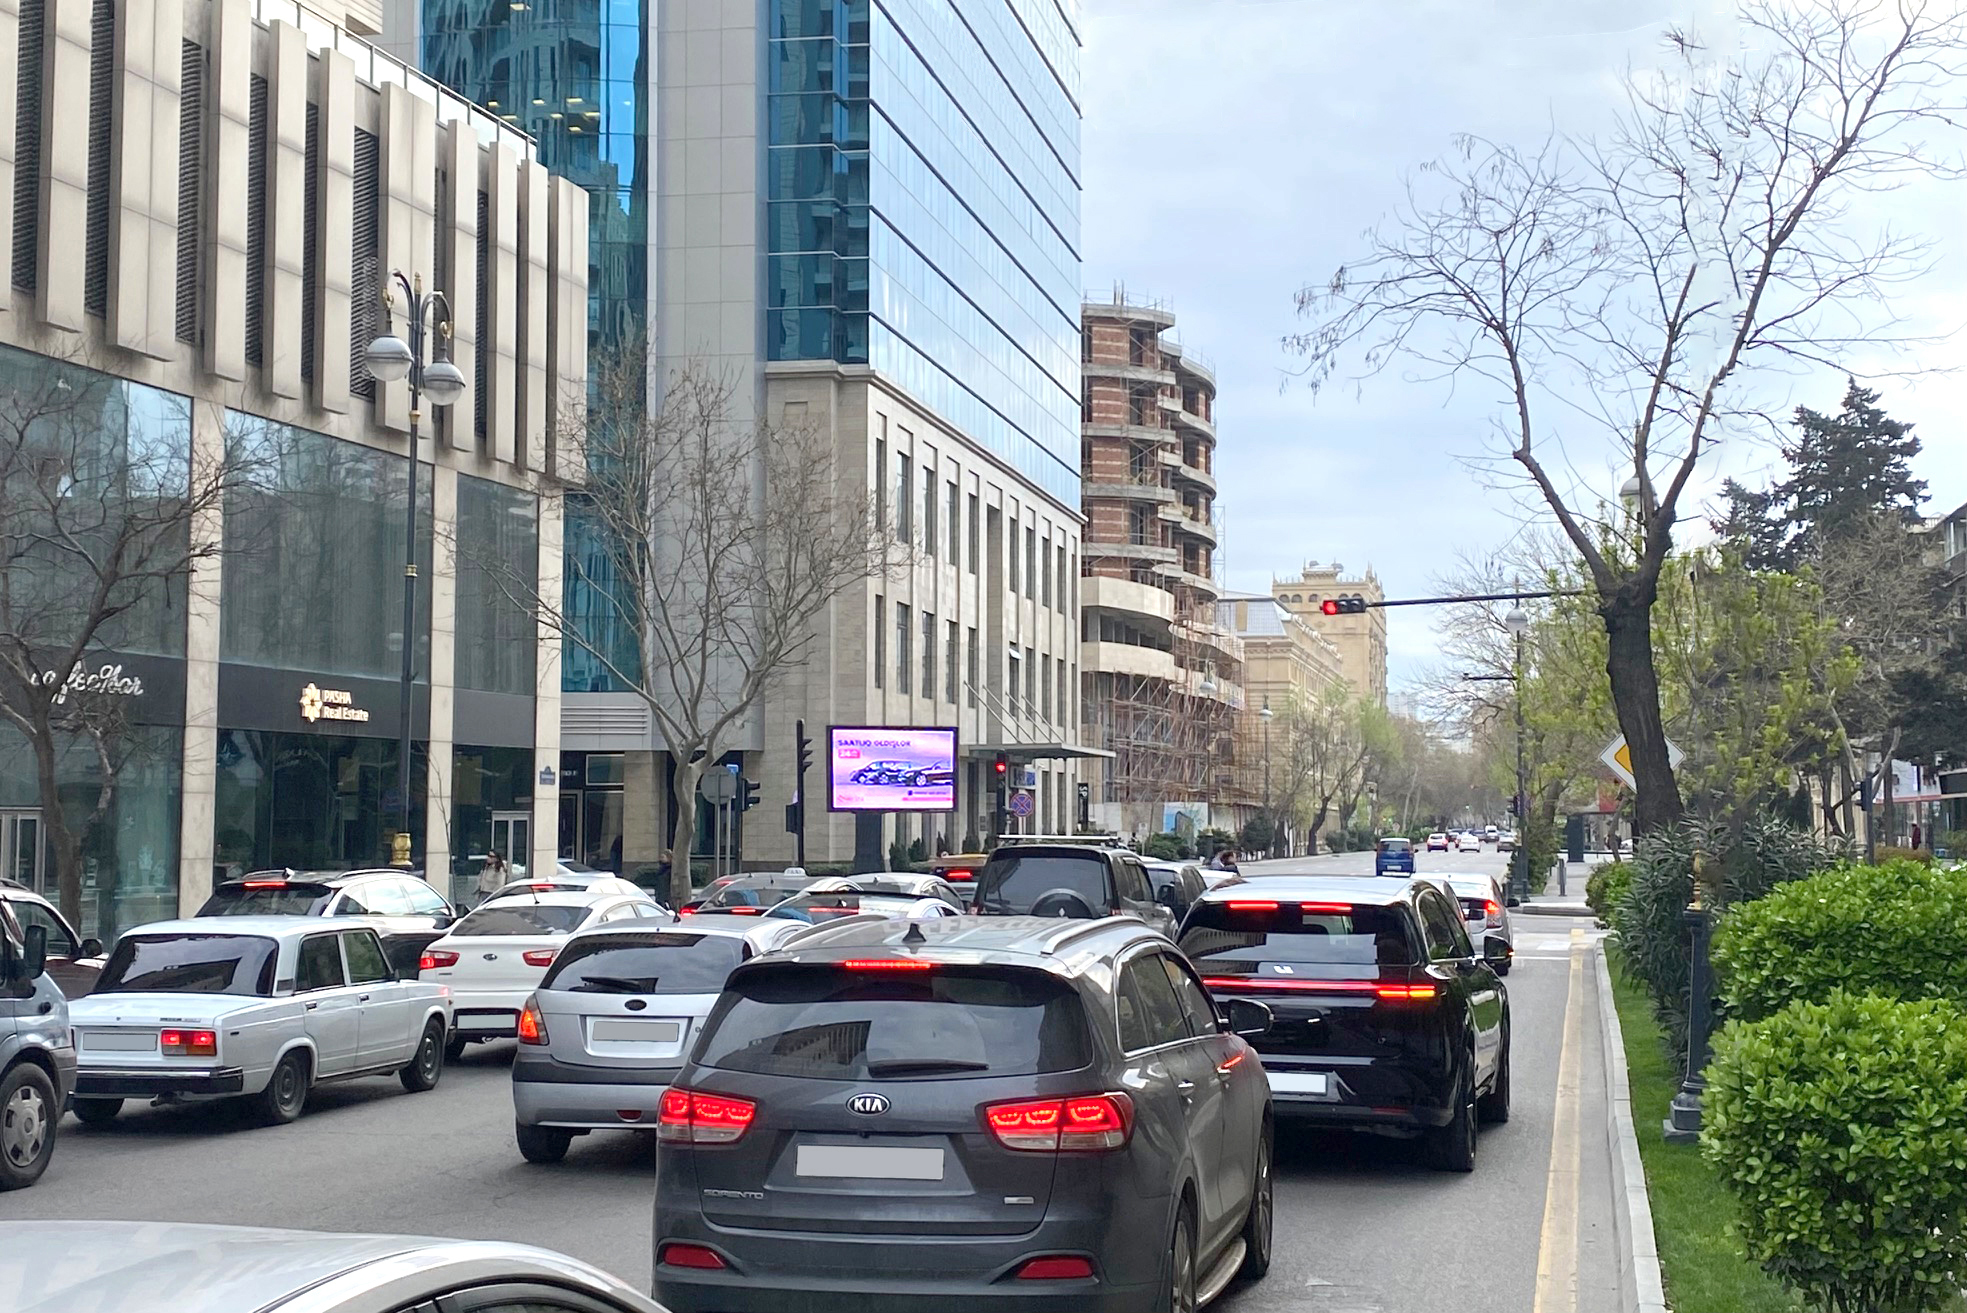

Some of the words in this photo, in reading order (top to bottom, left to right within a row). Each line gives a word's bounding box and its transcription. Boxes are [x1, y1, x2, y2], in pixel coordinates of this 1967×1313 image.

[322, 689, 352, 704] PASHA
[322, 706, 342, 719] Real
[343, 706, 369, 722] Estate
[853, 1097, 883, 1112] KIA
[703, 1188, 764, 1200] SORENTO
